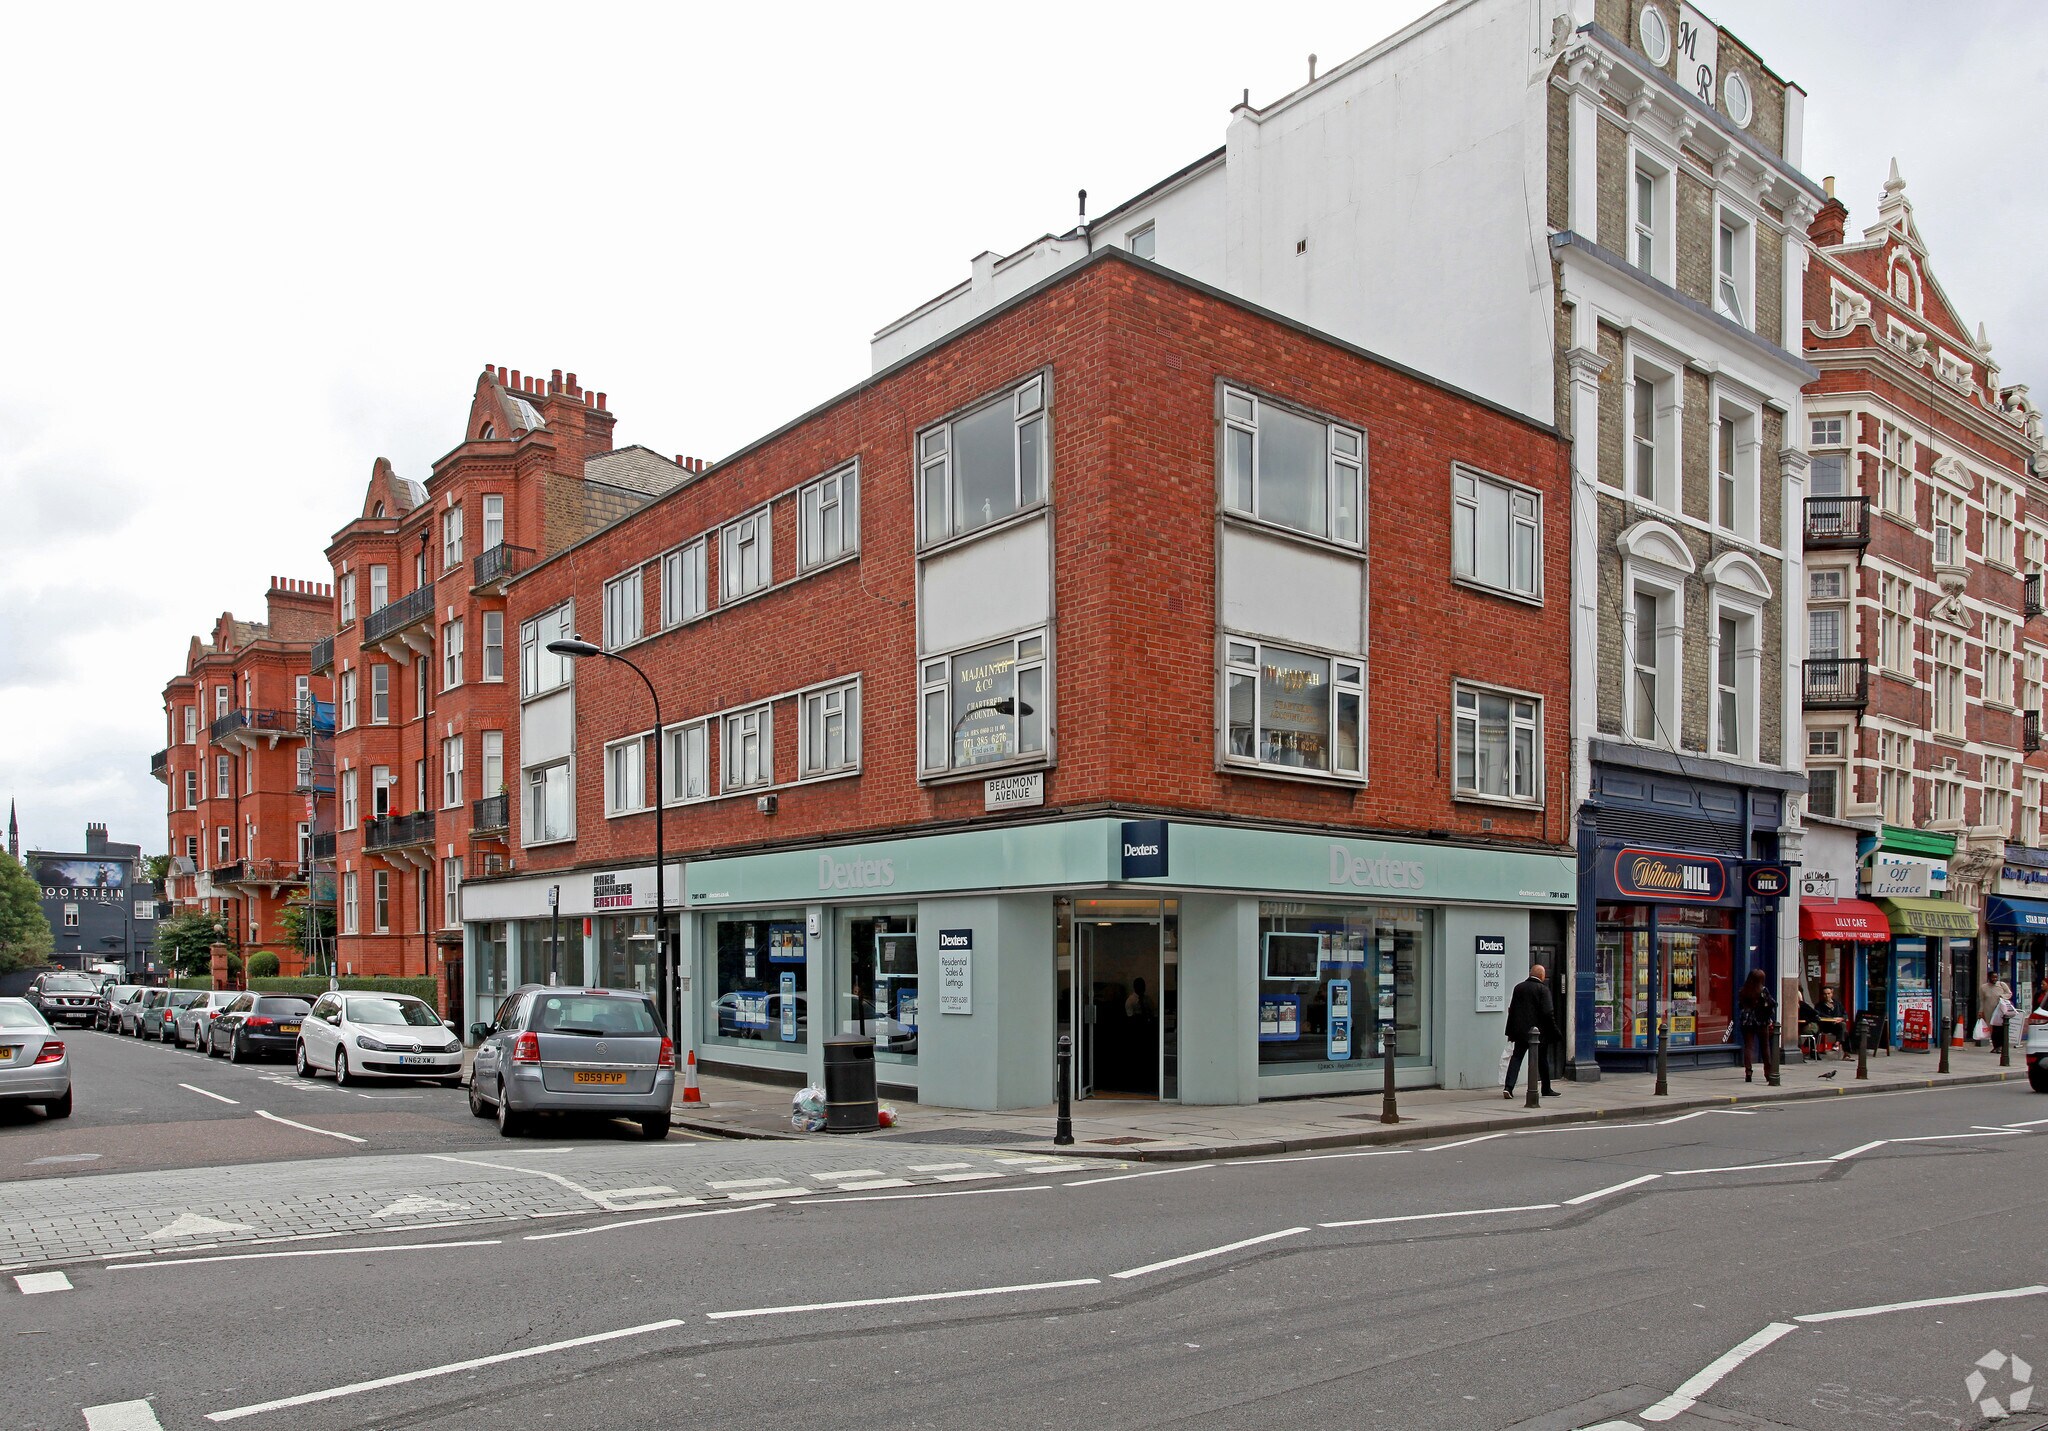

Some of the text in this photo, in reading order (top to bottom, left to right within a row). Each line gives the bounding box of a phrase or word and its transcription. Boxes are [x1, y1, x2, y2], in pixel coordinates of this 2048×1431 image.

[1678, 21, 1698, 61] M
[1697, 64, 1714, 108] R
[963, 732, 1007, 748] 071 385 6276
[990, 775, 1038, 791] BEAUMONT
[995, 787, 1030, 801] AVENUE
[1124, 843, 1159, 857] Dexters
[818, 854, 895, 890] Dexters
[1328, 844, 1425, 890] Dexters
[594, 874, 615, 886] MARK
[1632, 857, 1710, 891] William HILL
[1890, 867, 1911, 882] Off
[594, 883, 632, 897] SUMMERS
[1757, 880, 1778, 890] HILL
[1877, 883, 1921, 893] Licence
[594, 895, 632, 908] CASTING
[1835, 918, 1867, 928] LILLY CAFE
[1907, 911, 1972, 928] THE GRAPE VINE
[2025, 914, 2037, 924] STAR
[941, 934, 968, 946] Dexters
[1480, 940, 1503, 951] Dexters
[941, 957, 967, 966] Residential
[1479, 960, 1502, 969] Residential
[945, 967, 963, 976] Sales &
[1483, 969, 1495, 978] Sales
[1674, 969, 1693, 984] HERE
[945, 978, 964, 989] Lettings
[1483, 979, 1499, 989] Lettings
[577, 1073, 622, 1082] SD59 FVP
